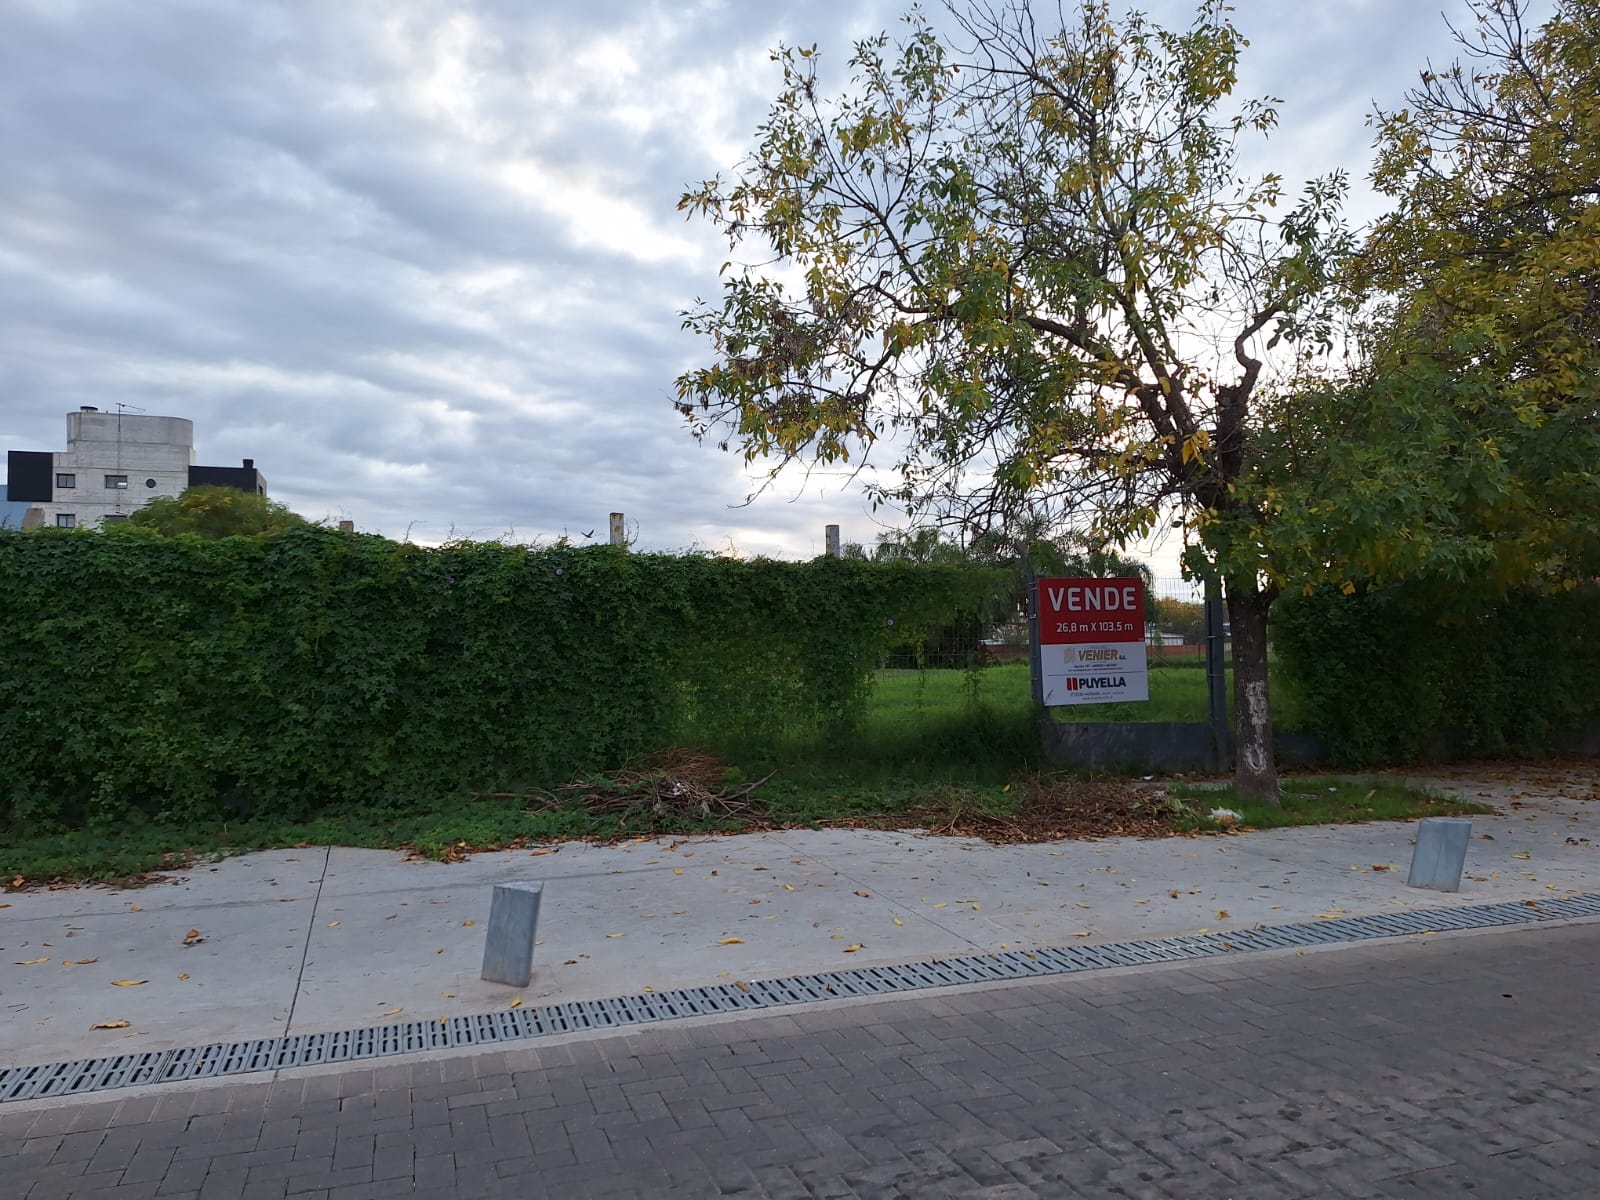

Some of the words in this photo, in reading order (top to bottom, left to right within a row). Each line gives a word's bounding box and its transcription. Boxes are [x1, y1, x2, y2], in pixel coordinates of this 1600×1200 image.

[1048, 587, 1136, 611] VENDE
[1079, 624, 1088, 632] m
[1099, 622, 1122, 631] 103.5
[1124, 623, 1133, 631] m
[1079, 649, 1119, 661] VENIER
[1079, 677, 1126, 689] PUYELLA
